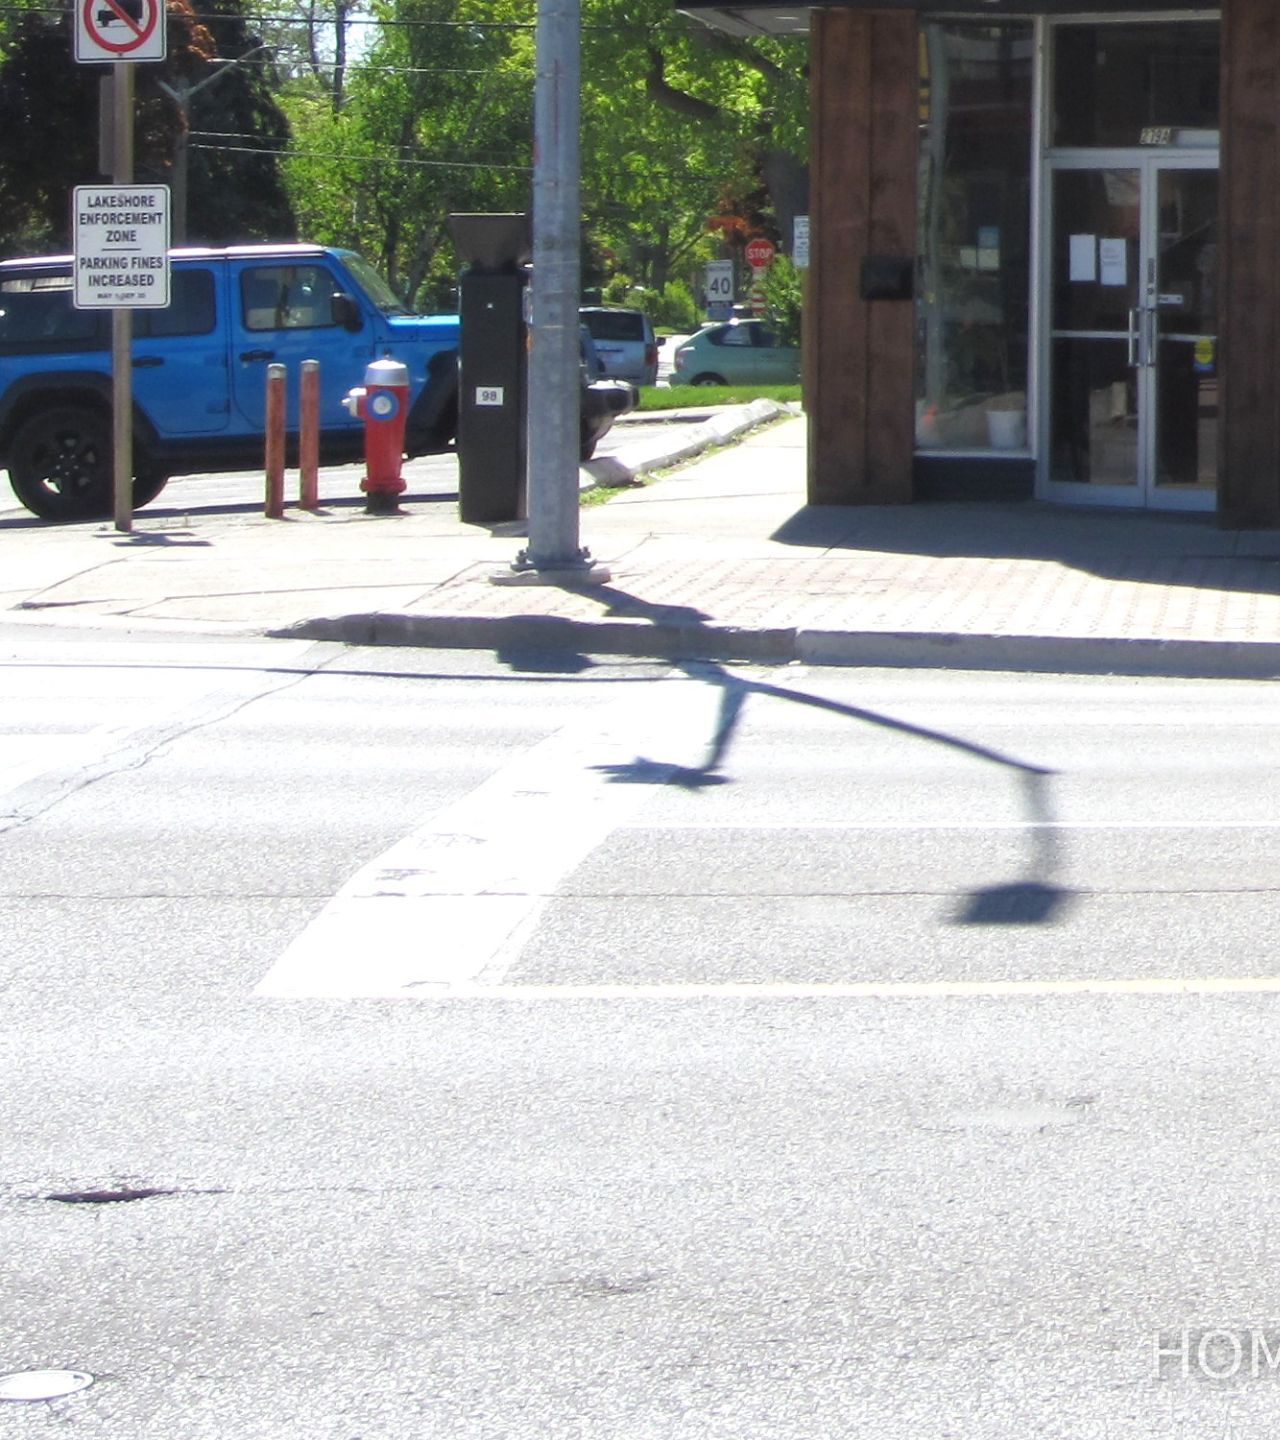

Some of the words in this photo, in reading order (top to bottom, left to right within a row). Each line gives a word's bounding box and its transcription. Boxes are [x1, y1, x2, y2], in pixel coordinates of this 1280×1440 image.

[87, 195, 155, 208] LAKESHORE
[80, 212, 163, 225] ENFORCEMENT
[105, 230, 137, 242] ZONE
[747, 247, 773, 259] STOP
[80, 257, 128, 269] PARKING
[131, 256, 163, 269] FINES
[88, 274, 155, 287] INCREASED
[710, 277, 731, 295] 40
[481, 390, 497, 401] 98
